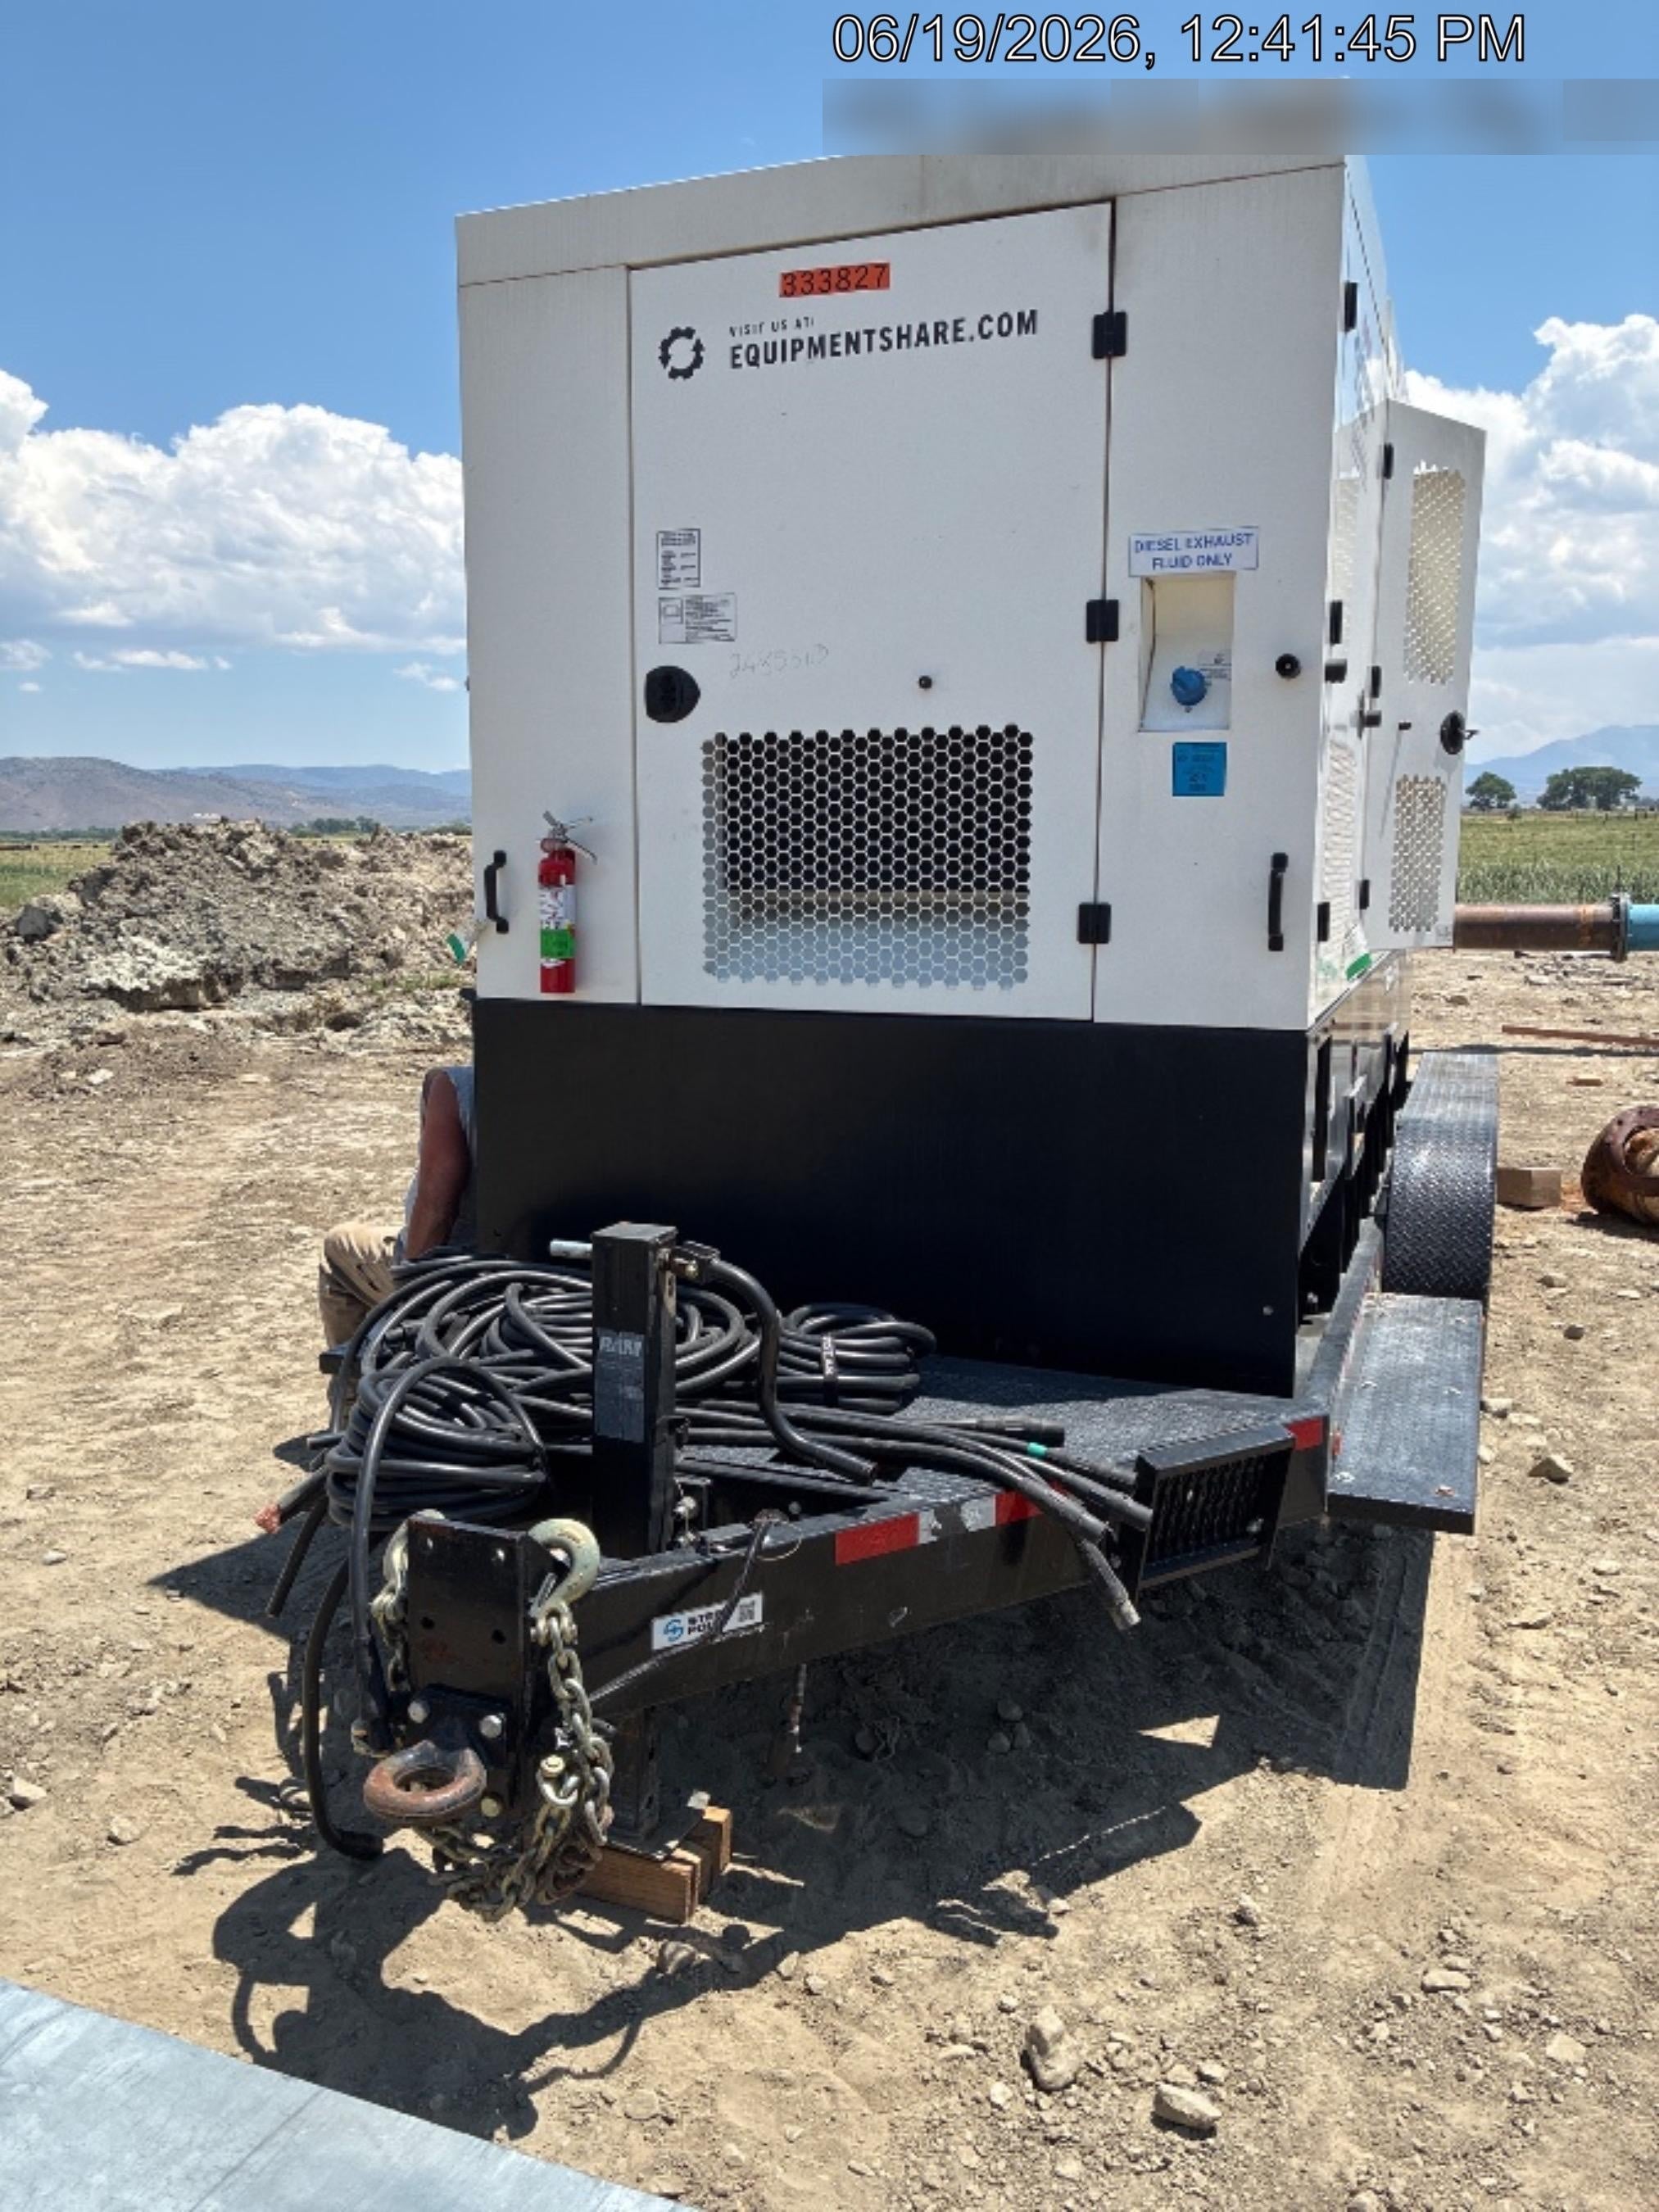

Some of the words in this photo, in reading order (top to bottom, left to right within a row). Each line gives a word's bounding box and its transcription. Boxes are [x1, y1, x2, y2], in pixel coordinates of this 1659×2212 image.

[782, 263, 886, 296] 333827
[771, 319, 787, 333] US
[731, 309, 1037, 369] EQUIPMENTSHARE.COM
[1135, 537, 1181, 553] DIESEL
[1186, 533, 1253, 549] EXHAUST
[1153, 555, 1193, 570] FLUID
[1196, 553, 1232, 567] ONLY
